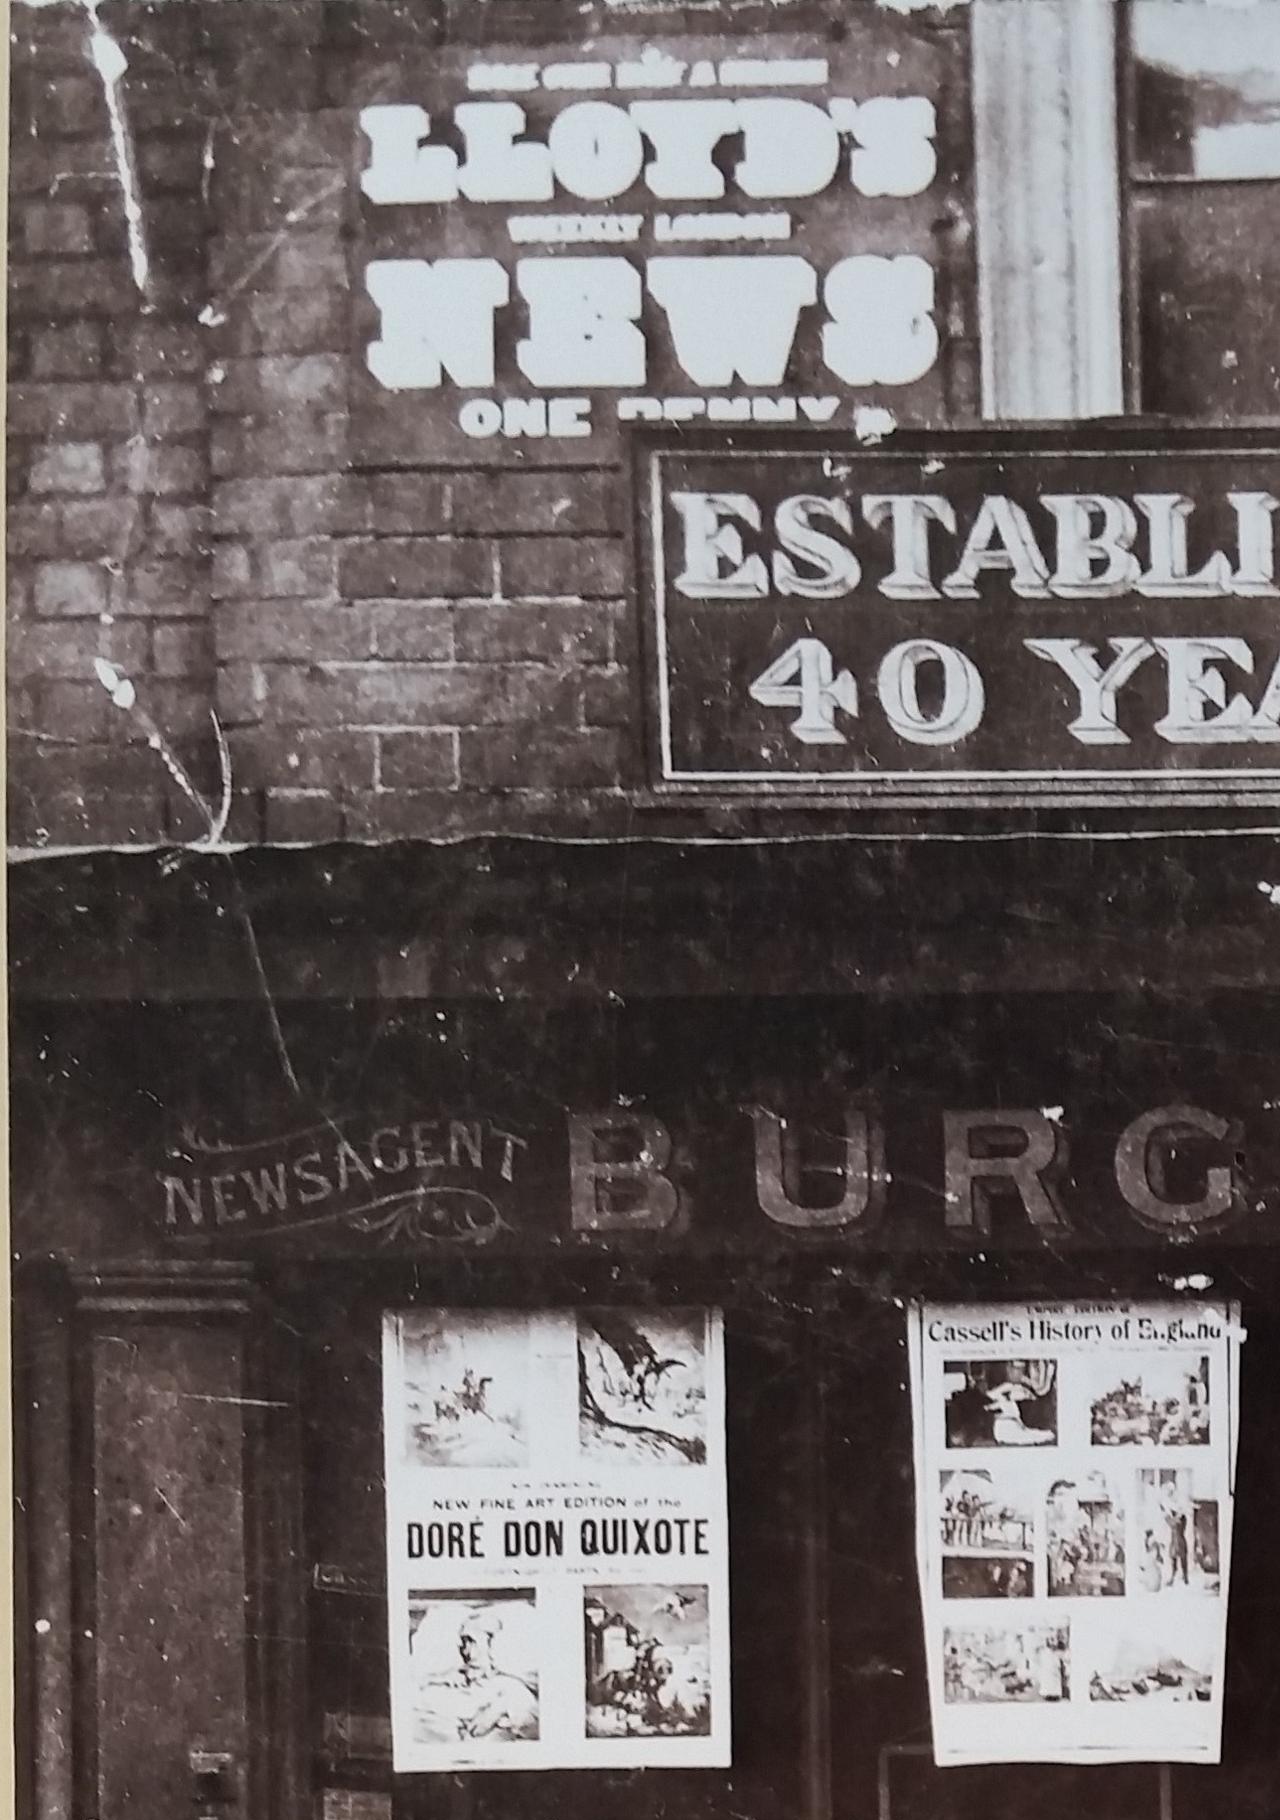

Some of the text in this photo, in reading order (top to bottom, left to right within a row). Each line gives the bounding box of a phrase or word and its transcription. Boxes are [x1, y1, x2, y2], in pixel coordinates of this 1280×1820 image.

[360, 97, 937, 204] LLOYD'S
[366, 254, 938, 388] NEWS
[459, 398, 592, 438] ONE
[749, 638, 985, 745] 40
[156, 1118, 528, 1226] NEWSAGENT
[928, 1320, 1022, 1344] Cassell's
[1029, 1319, 1102, 1344] History
[1111, 1318, 1131, 1340] of
[432, 1498, 469, 1510] NEW
[480, 1498, 515, 1510] FINE
[525, 1497, 552, 1509] ART
[564, 1496, 627, 1509] EDITION
[504, 1519, 564, 1558] DON
[580, 1518, 710, 1557] QUIXOTE
